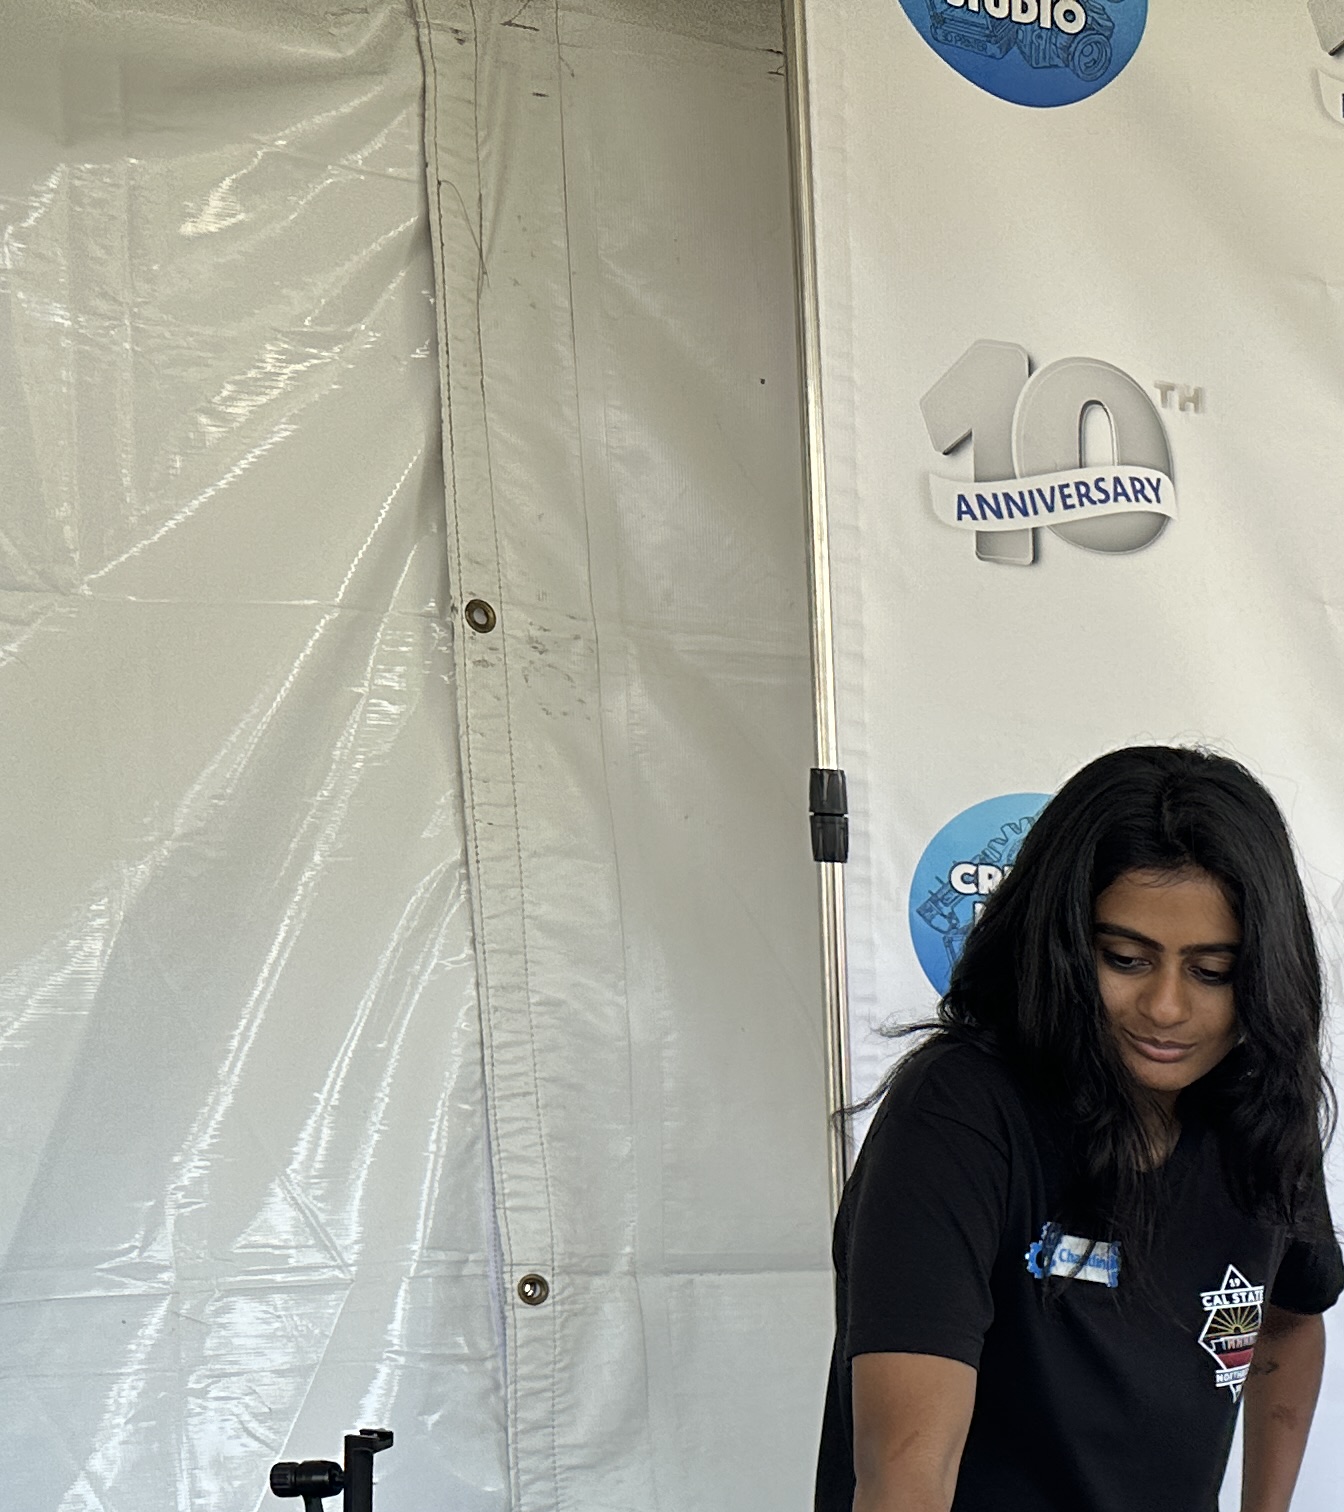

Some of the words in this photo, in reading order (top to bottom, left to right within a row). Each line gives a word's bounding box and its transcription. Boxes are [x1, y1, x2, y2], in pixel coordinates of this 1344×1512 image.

[957, 476, 1161, 521] ANNIVERSARY
[1202, 1294, 1230, 1307] CAL
[1231, 1290, 1263, 1304] STATE
